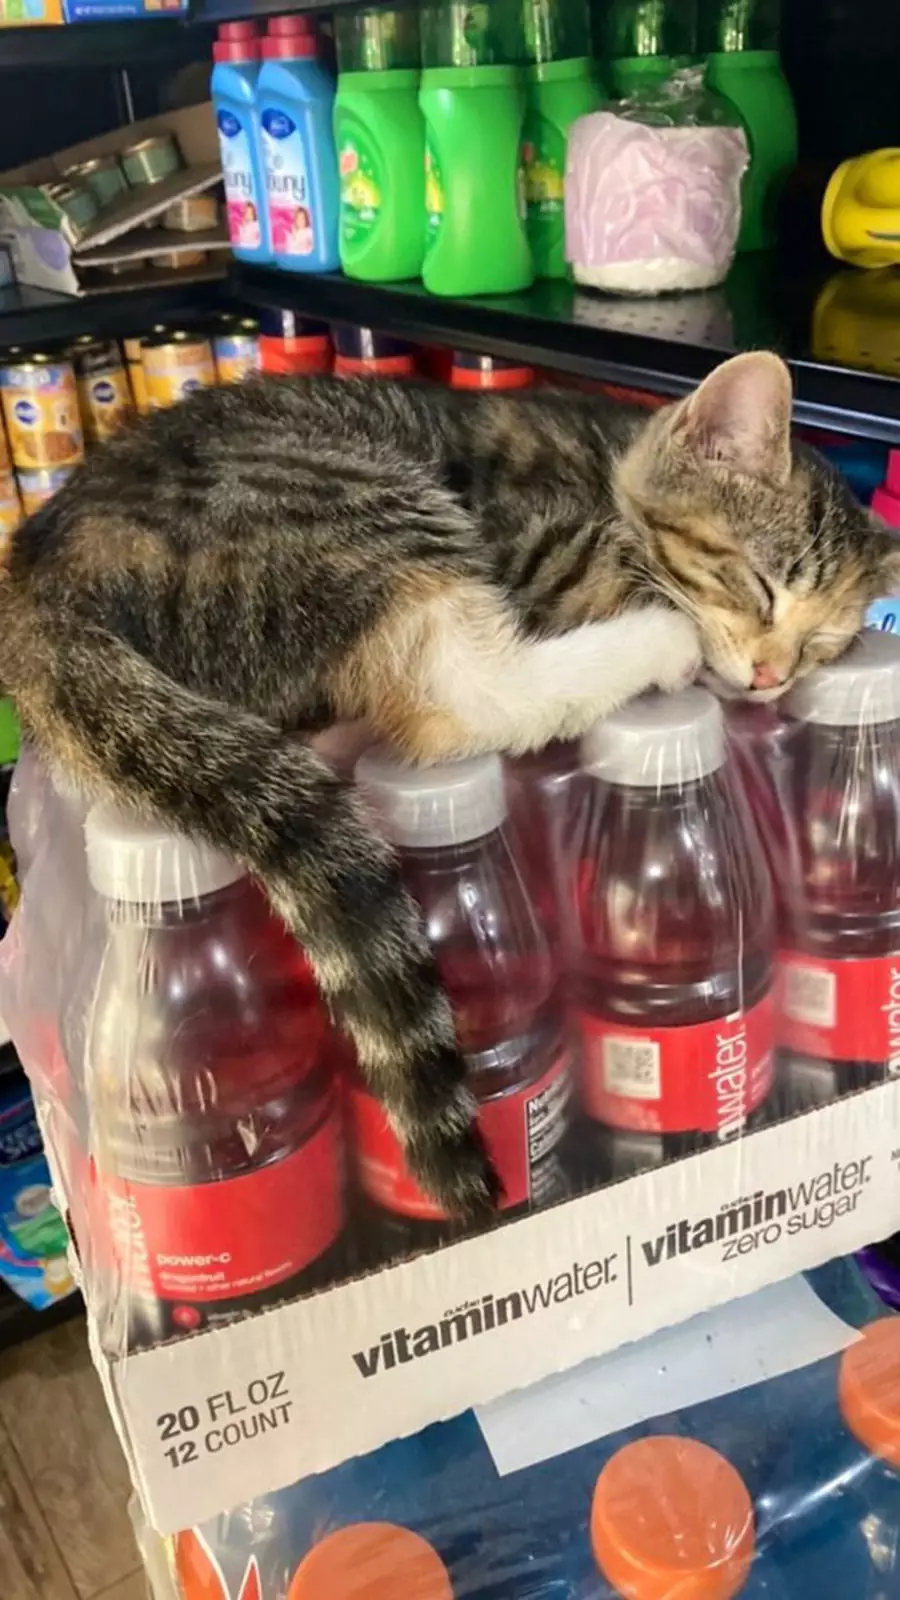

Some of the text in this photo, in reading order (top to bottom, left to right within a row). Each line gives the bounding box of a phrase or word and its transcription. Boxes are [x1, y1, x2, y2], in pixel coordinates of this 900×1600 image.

[156, 1252, 232, 1268] power-c
[721, 1190, 862, 1262] zero sugar
[156, 1370, 289, 1441] 20 FL OZ
[164, 1401, 293, 1468] 12 COUNT
